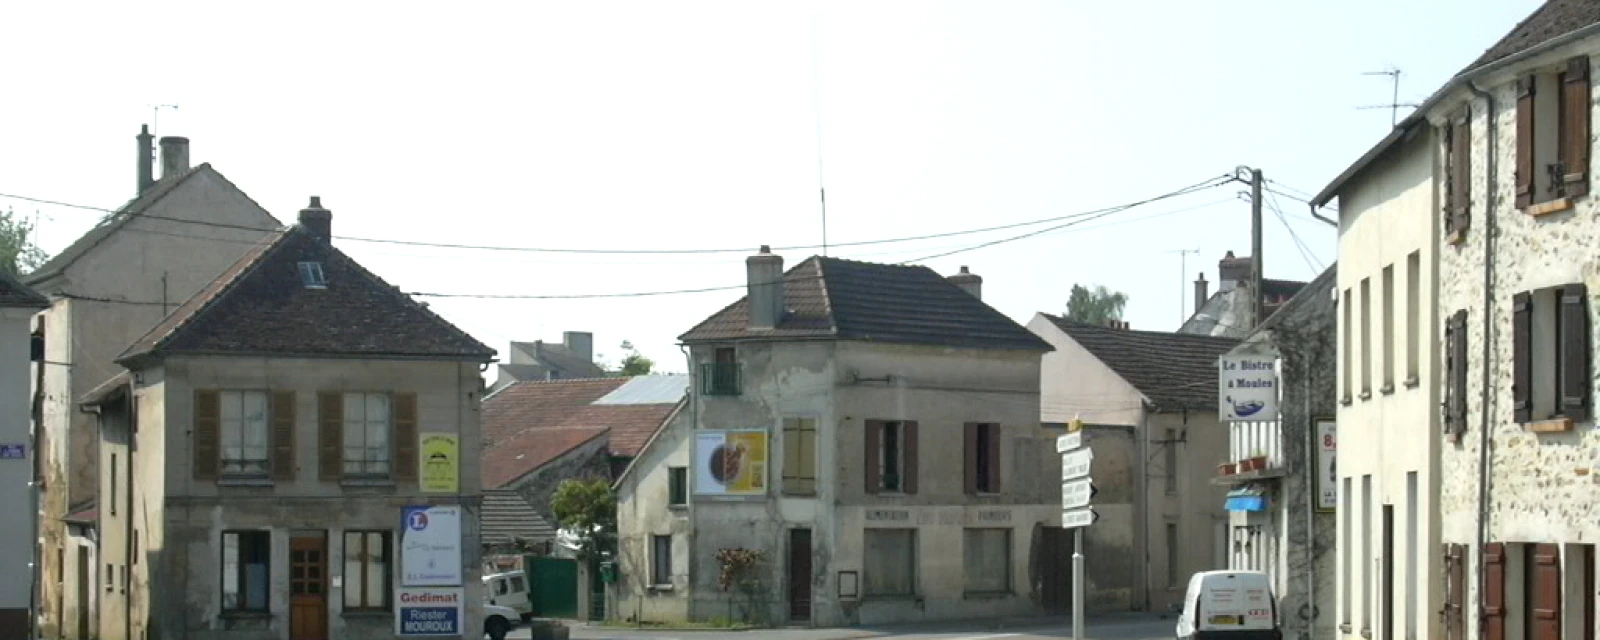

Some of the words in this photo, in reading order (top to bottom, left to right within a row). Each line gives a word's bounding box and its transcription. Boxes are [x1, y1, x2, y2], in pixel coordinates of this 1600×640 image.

[1224, 360, 1236, 370] Le
[1241, 360, 1272, 370] Bistro
[1236, 378, 1272, 388] Moules
[401, 592, 457, 602] Gedimat
[410, 609, 448, 620] Riester
[405, 621, 453, 631] MOUROUX
